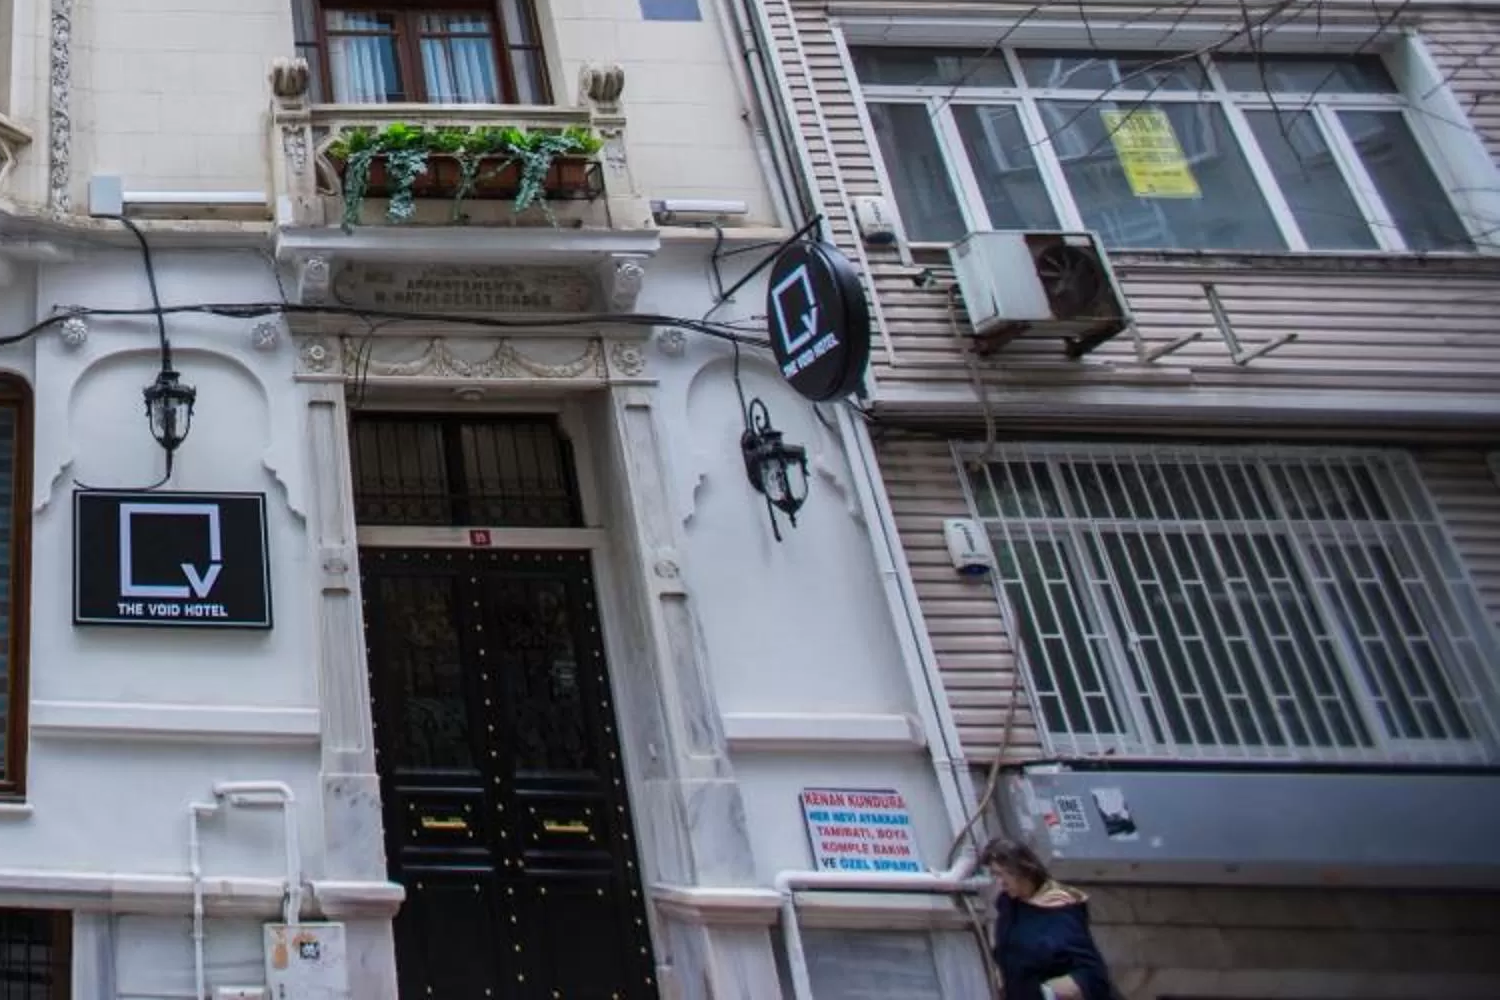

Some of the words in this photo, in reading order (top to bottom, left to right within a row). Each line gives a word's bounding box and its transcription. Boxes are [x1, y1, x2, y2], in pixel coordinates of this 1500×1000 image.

[117, 603, 144, 616] THE
[148, 603, 181, 617] VOID
[184, 604, 229, 618] HOTEL
[804, 791, 846, 807] KENAN
[846, 794, 906, 809] KUNDURA
[820, 858, 837, 868] VE
